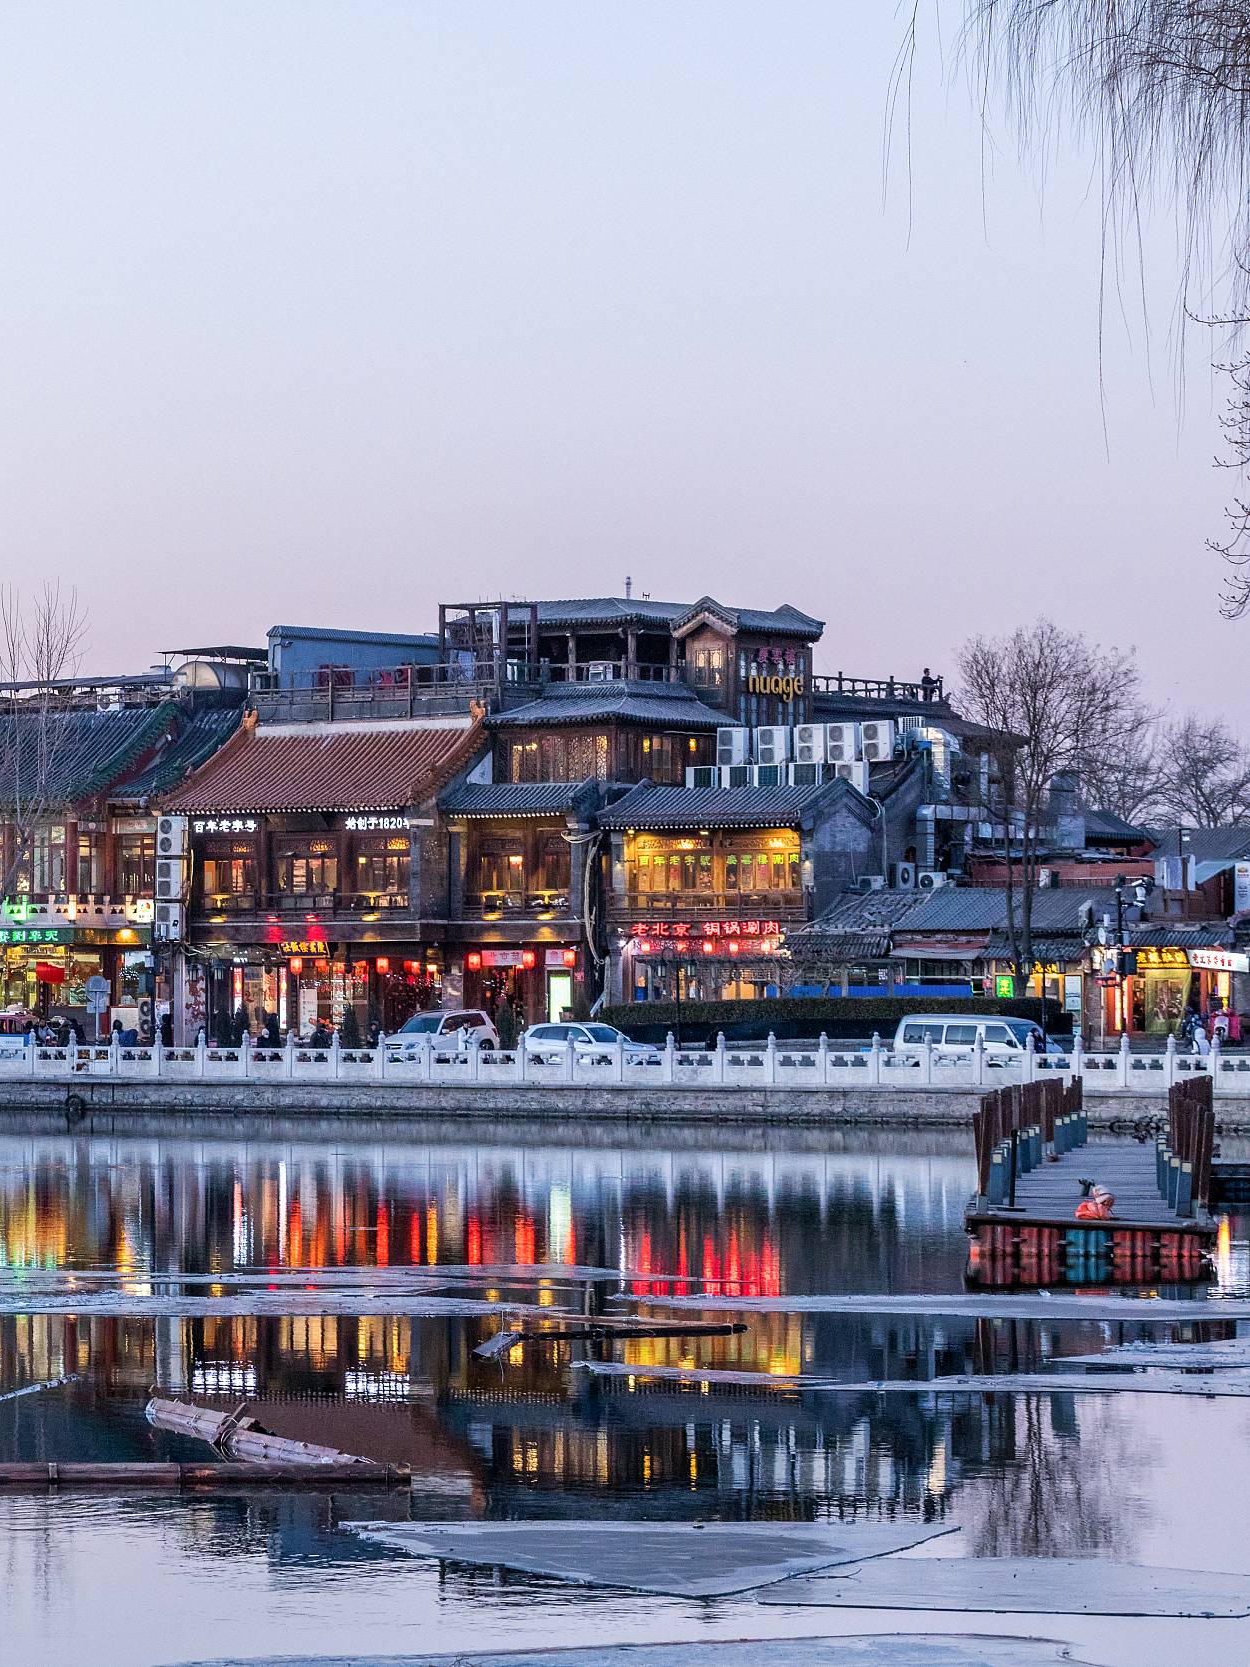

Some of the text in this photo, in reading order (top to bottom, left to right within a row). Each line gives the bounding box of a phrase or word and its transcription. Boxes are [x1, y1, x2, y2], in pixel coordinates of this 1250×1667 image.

[748, 674, 804, 703] nuage
[631, 920, 781, 936] 老北京 铜锅涮肉
